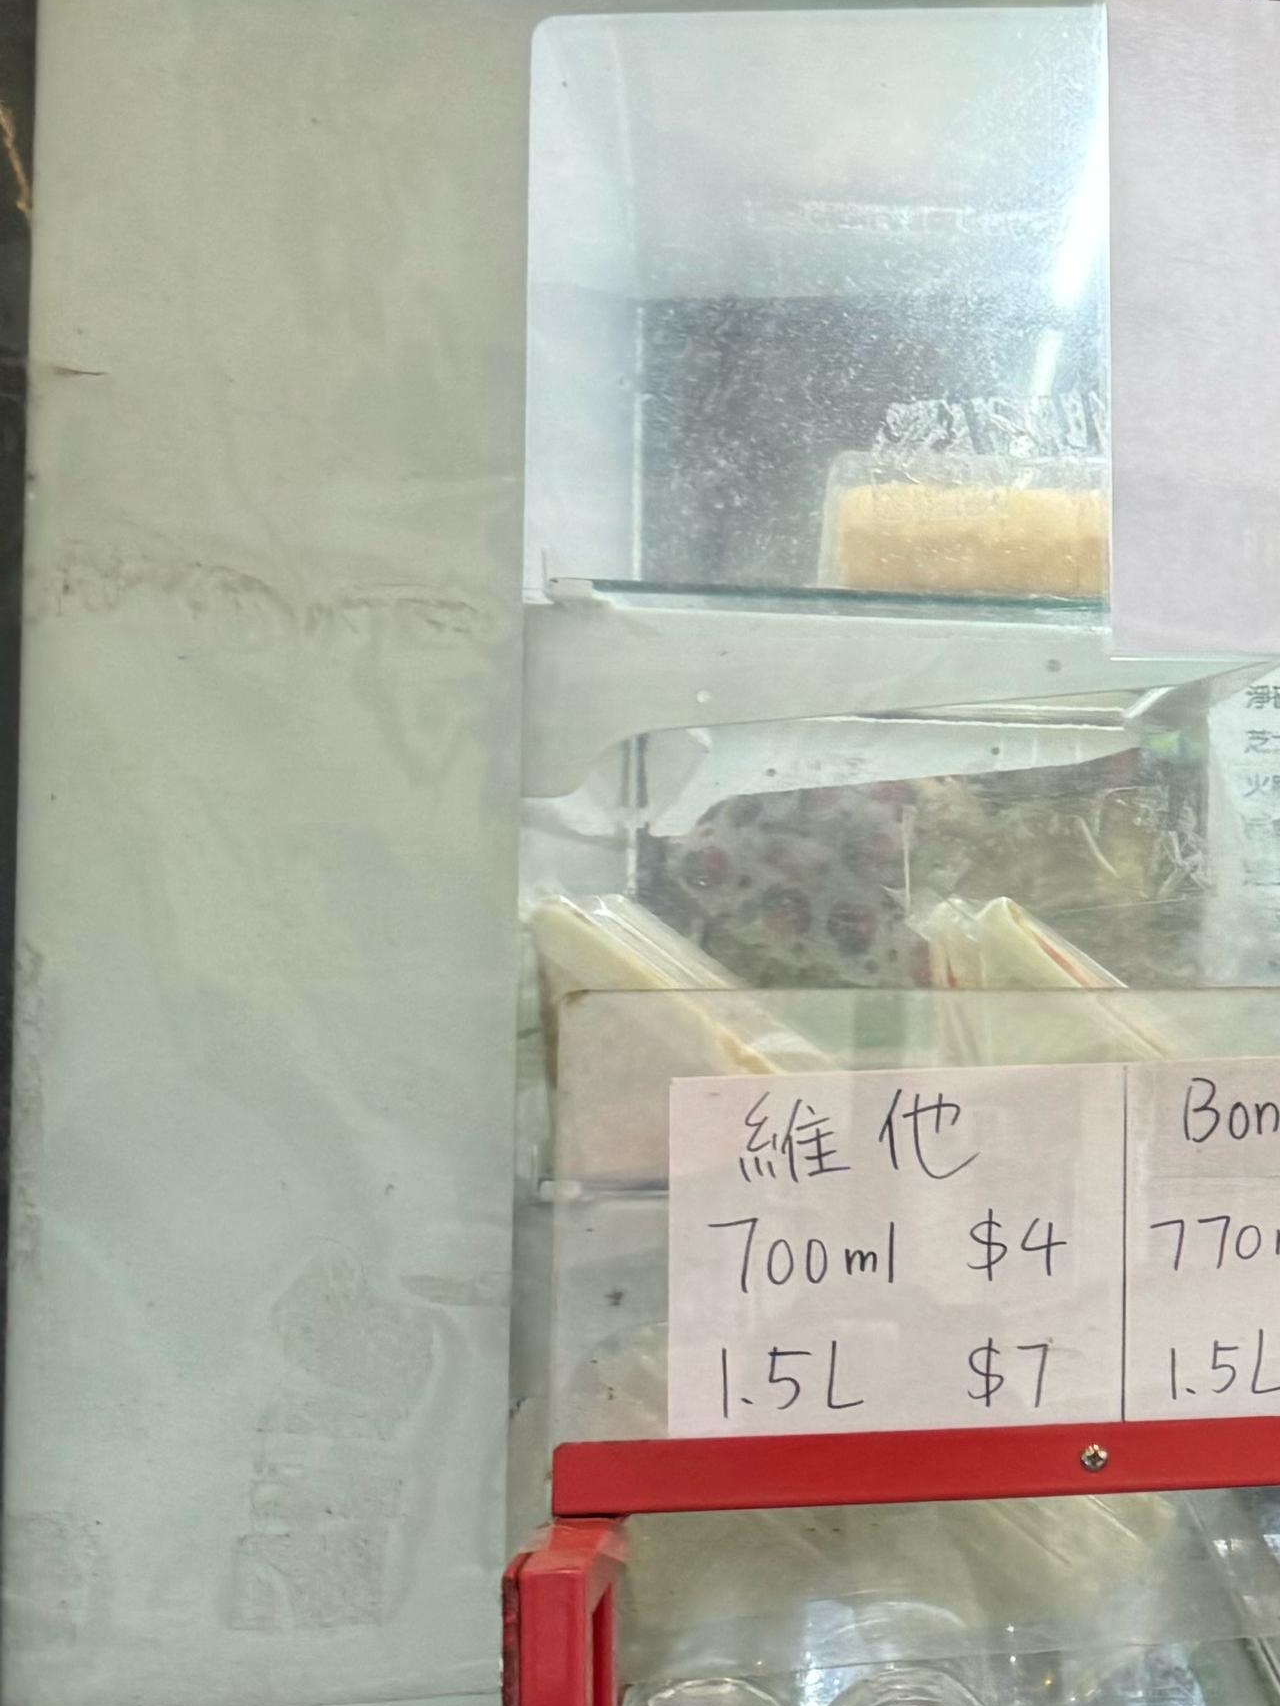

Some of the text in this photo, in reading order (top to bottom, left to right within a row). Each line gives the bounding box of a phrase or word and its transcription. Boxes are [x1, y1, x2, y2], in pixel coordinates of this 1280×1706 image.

[967, 1209, 1068, 1283] $4
[720, 1338, 1051, 1419] 1.5L $7
